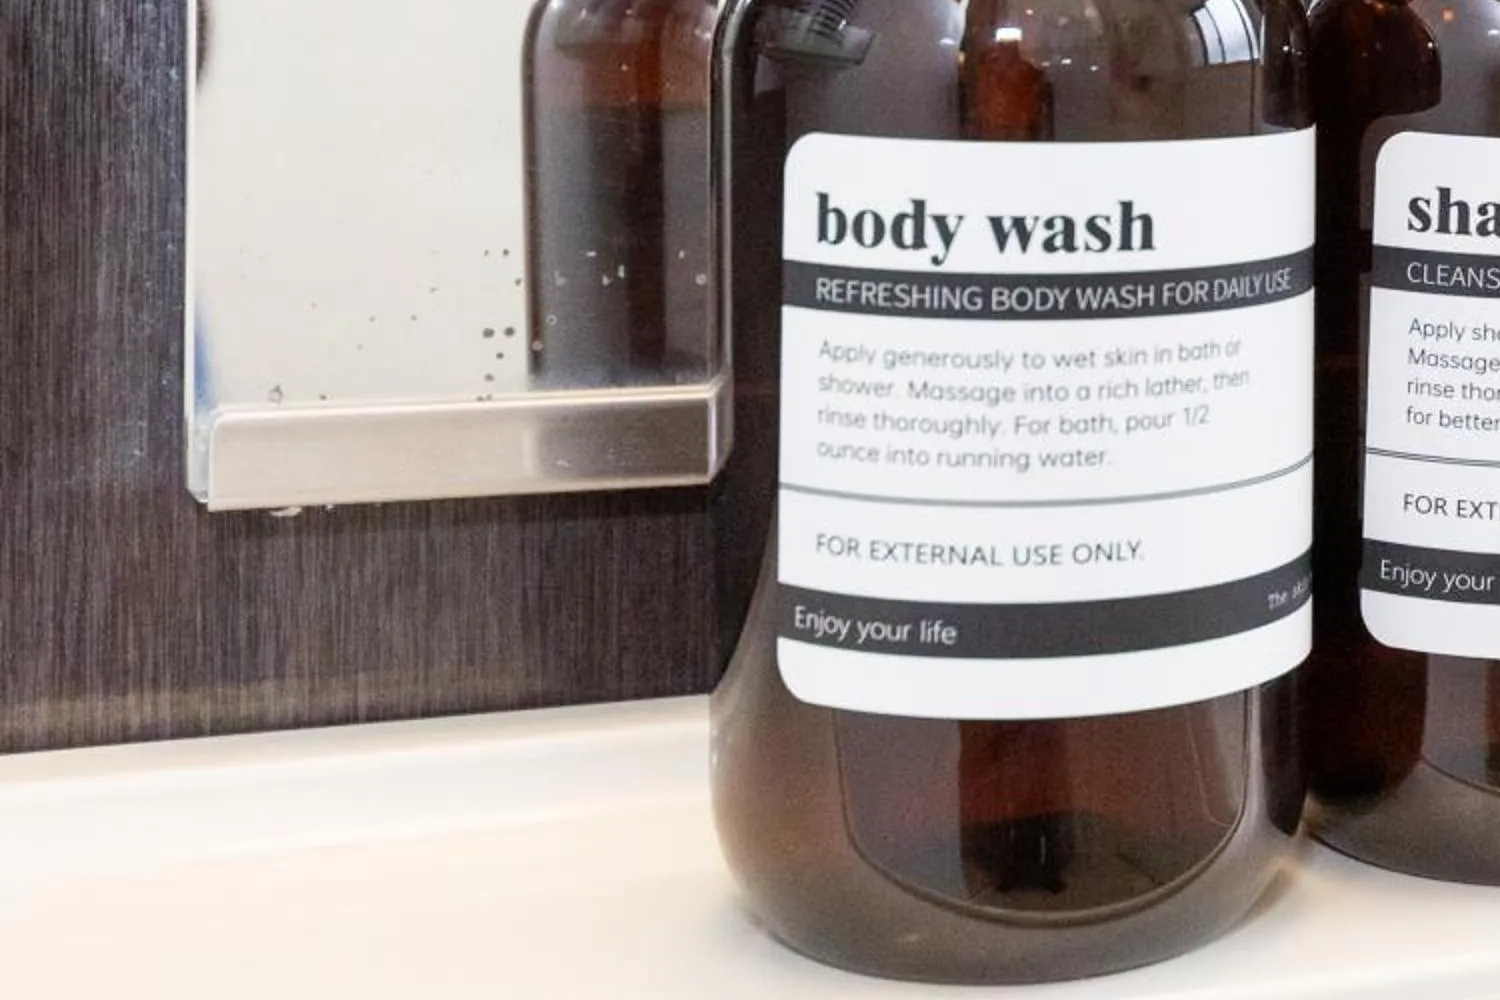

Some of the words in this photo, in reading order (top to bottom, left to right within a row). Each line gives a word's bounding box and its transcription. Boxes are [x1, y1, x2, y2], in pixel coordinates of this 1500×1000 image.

[815, 192, 964, 266] body
[987, 201, 1156, 254] wash
[815, 277, 983, 312] REFRESHING
[992, 286, 1073, 312] BODY
[1076, 284, 1154, 311] WASH
[1162, 279, 1208, 305] FOR
[1214, 272, 1264, 300] DAILY
[1265, 266, 1292, 293] USE
[1409, 317, 1465, 341] Apply
[820, 339, 876, 365] Apply
[883, 348, 1013, 373] generously
[1023, 350, 1045, 369] to
[1053, 351, 1096, 369] wet
[1104, 346, 1147, 366] skin
[1153, 343, 1172, 364] in
[1178, 340, 1220, 362] bath
[1225, 339, 1241, 357] or
[1408, 348, 1500, 372] Massage
[909, 380, 1016, 408] Massage
[1024, 382, 1069, 401] into
[1076, 385, 1090, 400] a
[1098, 378, 1138, 399] rich
[1144, 373, 1208, 396] lather,
[1213, 367, 1249, 390] then
[1407, 377, 1454, 399] rinse
[818, 405, 867, 429] rinse
[872, 411, 1006, 440] thoroughly.
[1014, 414, 1055, 435] For
[1059, 414, 1118, 435] bath,
[1125, 409, 1175, 432] pour
[1183, 402, 1209, 426] 1/2
[1406, 407, 1431, 426] for
[1439, 411, 1500, 432] better
[817, 441, 880, 463] ounce
[886, 444, 929, 466] into
[936, 448, 1031, 472] running
[1039, 448, 1112, 468] water.
[1403, 494, 1448, 516] FOR
[815, 533, 861, 559] FOR
[870, 540, 1003, 566] EXTERNAL
[1013, 543, 1063, 566] USE
[1073, 540, 1144, 563] ONLY.
[1380, 559, 1436, 591] Enjoy
[1443, 569, 1495, 593] your
[794, 605, 851, 641] Enjoy
[857, 618, 910, 643] your
[919, 619, 958, 646] life
